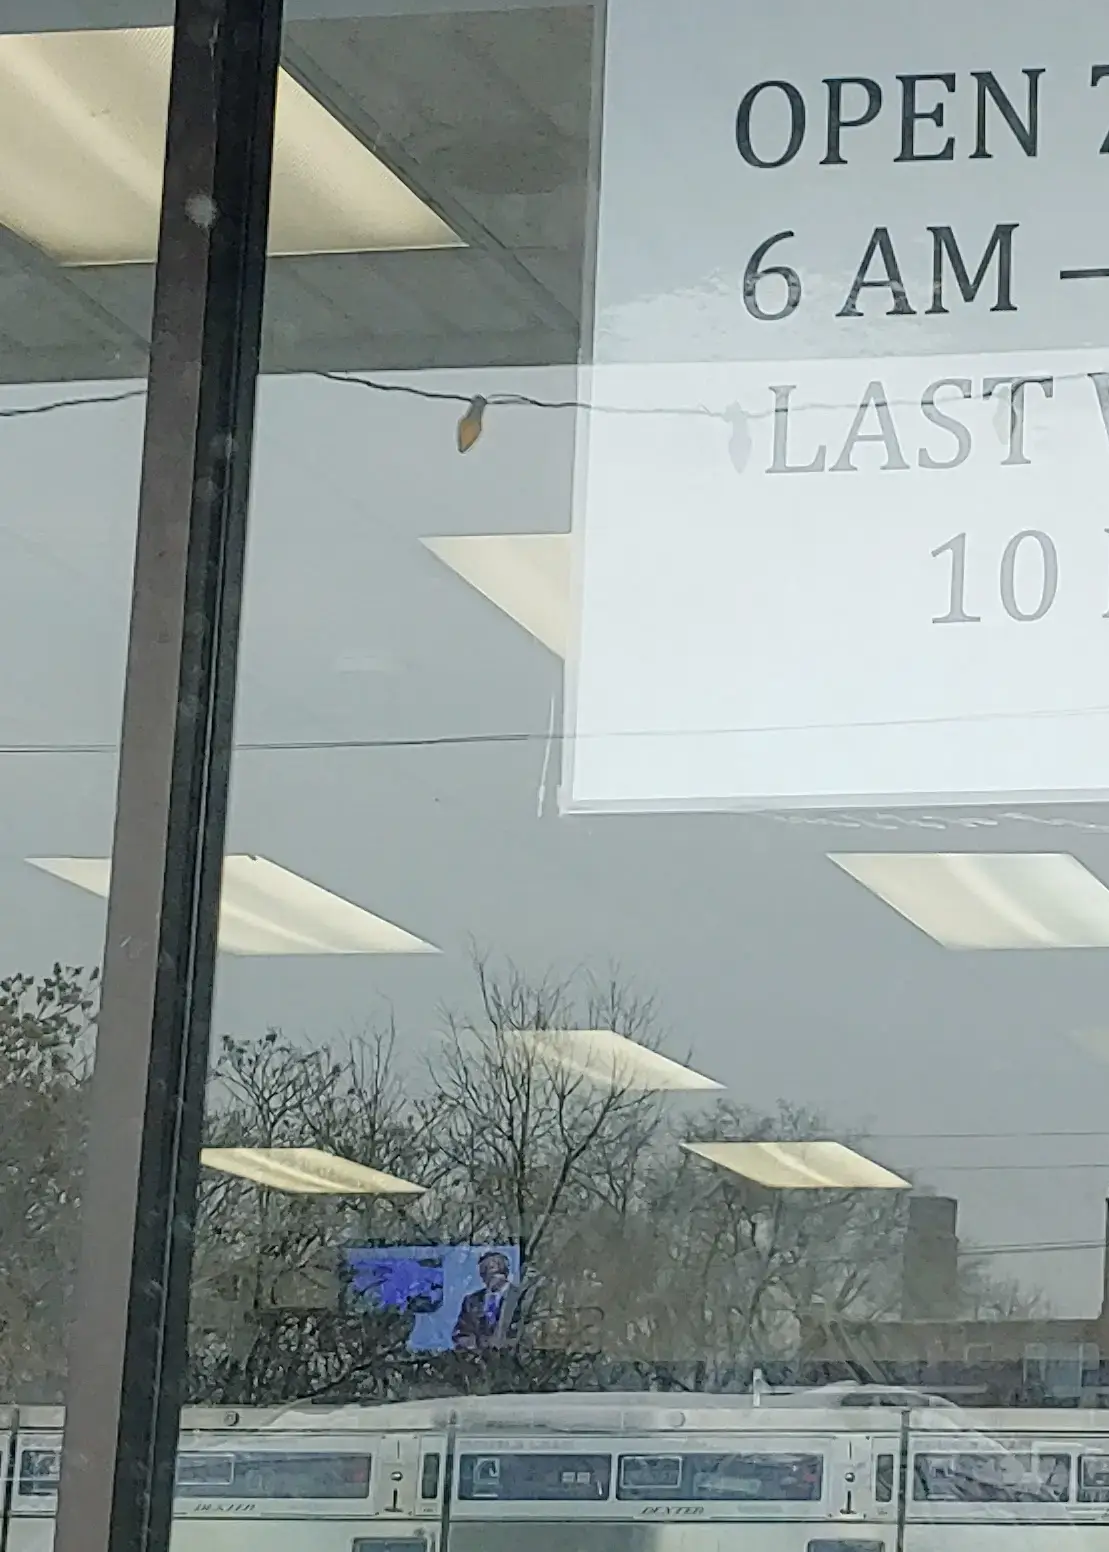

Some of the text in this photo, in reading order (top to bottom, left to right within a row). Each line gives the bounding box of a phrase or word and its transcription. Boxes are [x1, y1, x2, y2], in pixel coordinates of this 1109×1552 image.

[736, 69, 1045, 168] OPEN
[743, 231, 801, 321] 6
[836, 224, 1020, 317] AM
[766, 378, 1053, 474] LAST
[931, 530, 1058, 624] 10
